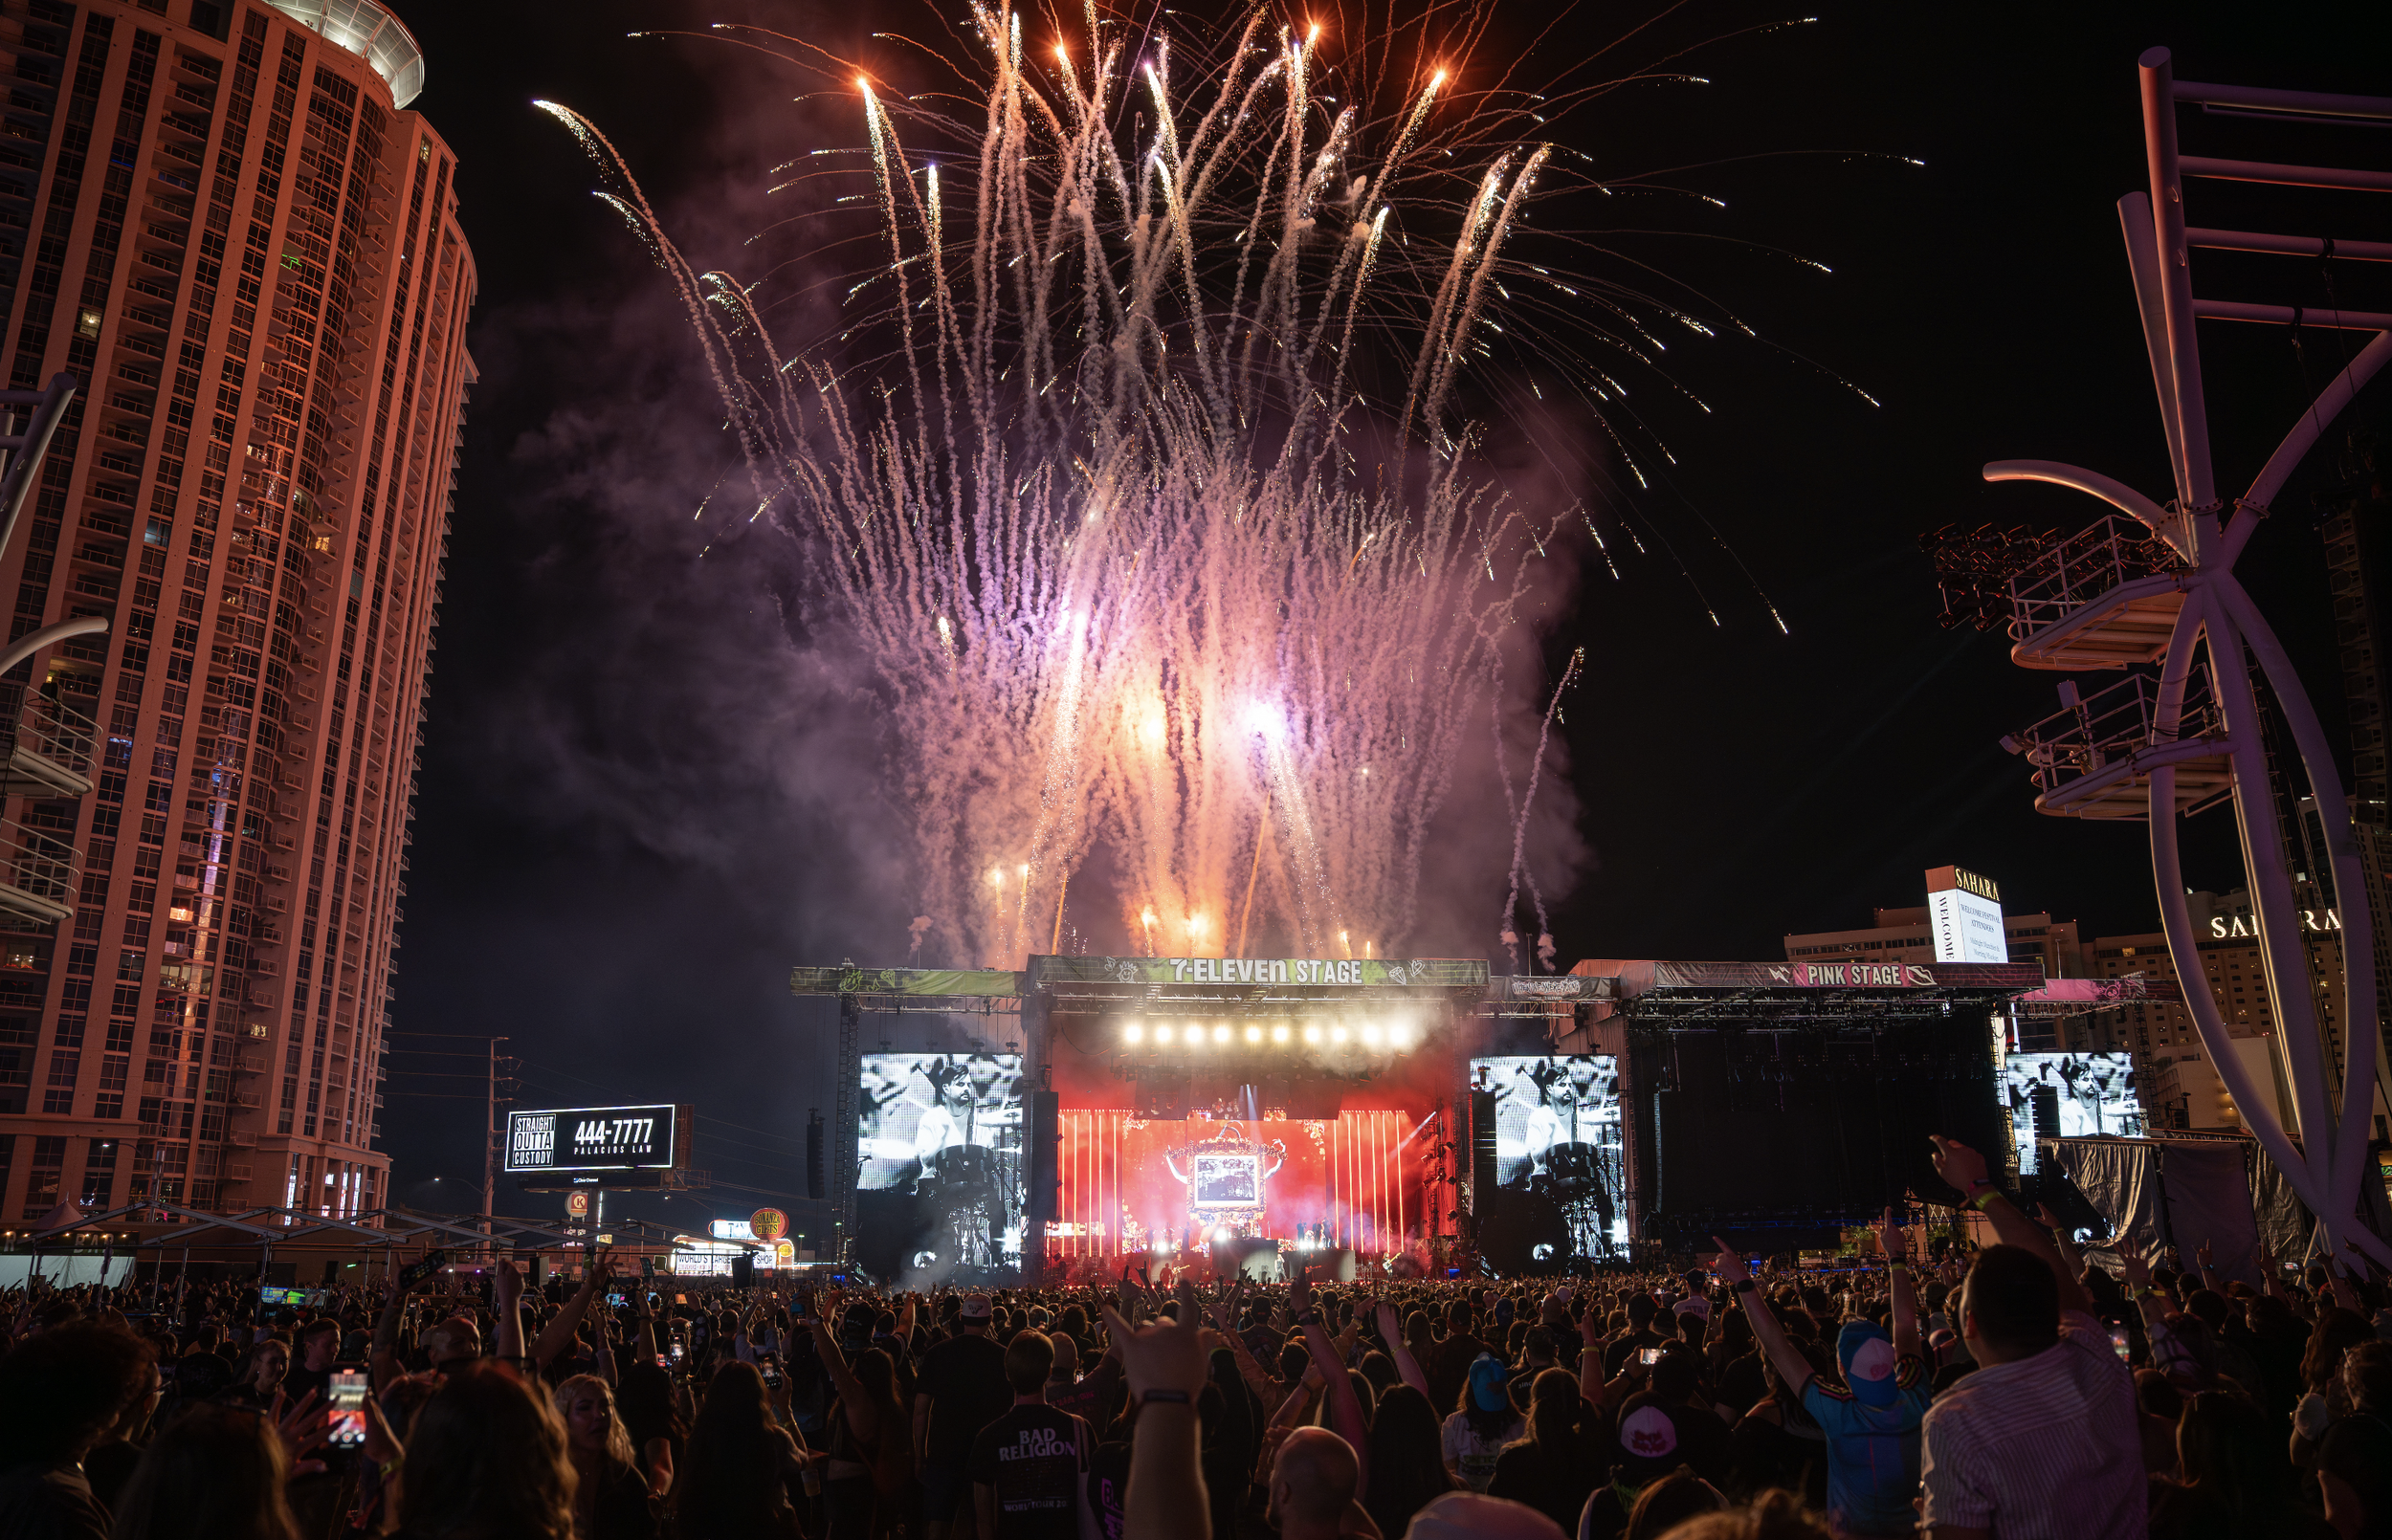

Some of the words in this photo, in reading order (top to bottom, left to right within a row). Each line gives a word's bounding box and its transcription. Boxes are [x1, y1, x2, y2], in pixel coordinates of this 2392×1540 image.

[1955, 869, 2000, 901] SAHARA
[1939, 896, 1955, 960] WELCOME
[2210, 908, 2341, 938] SARA
[1296, 959, 1362, 984] STAGE
[1807, 964, 1847, 986] PINK
[1850, 964, 1902, 986] STAGE
[517, 1116, 554, 1133] STRAIGHT
[574, 1118, 653, 1146] 444-7777
[516, 1132, 552, 1150] OUTTA
[514, 1151, 552, 1165] CUSTODY
[574, 1146, 625, 1155] PALACIOS
[632, 1145, 652, 1154] LAW
[576, 1198, 584, 1207] K
[754, 1211, 781, 1223] BONANZA
[757, 1224, 778, 1234] GIFTS
[678, 1254, 708, 1264] WORLDS
[711, 1255, 733, 1265] ARGE
[756, 1254, 773, 1265] SHOP
[1019, 1427, 1056, 1445] BAD
[999, 1441, 1076, 1462] RELIGION
[1004, 1502, 1030, 1512] WORL
[1030, 1500, 1054, 1509] TOUR
